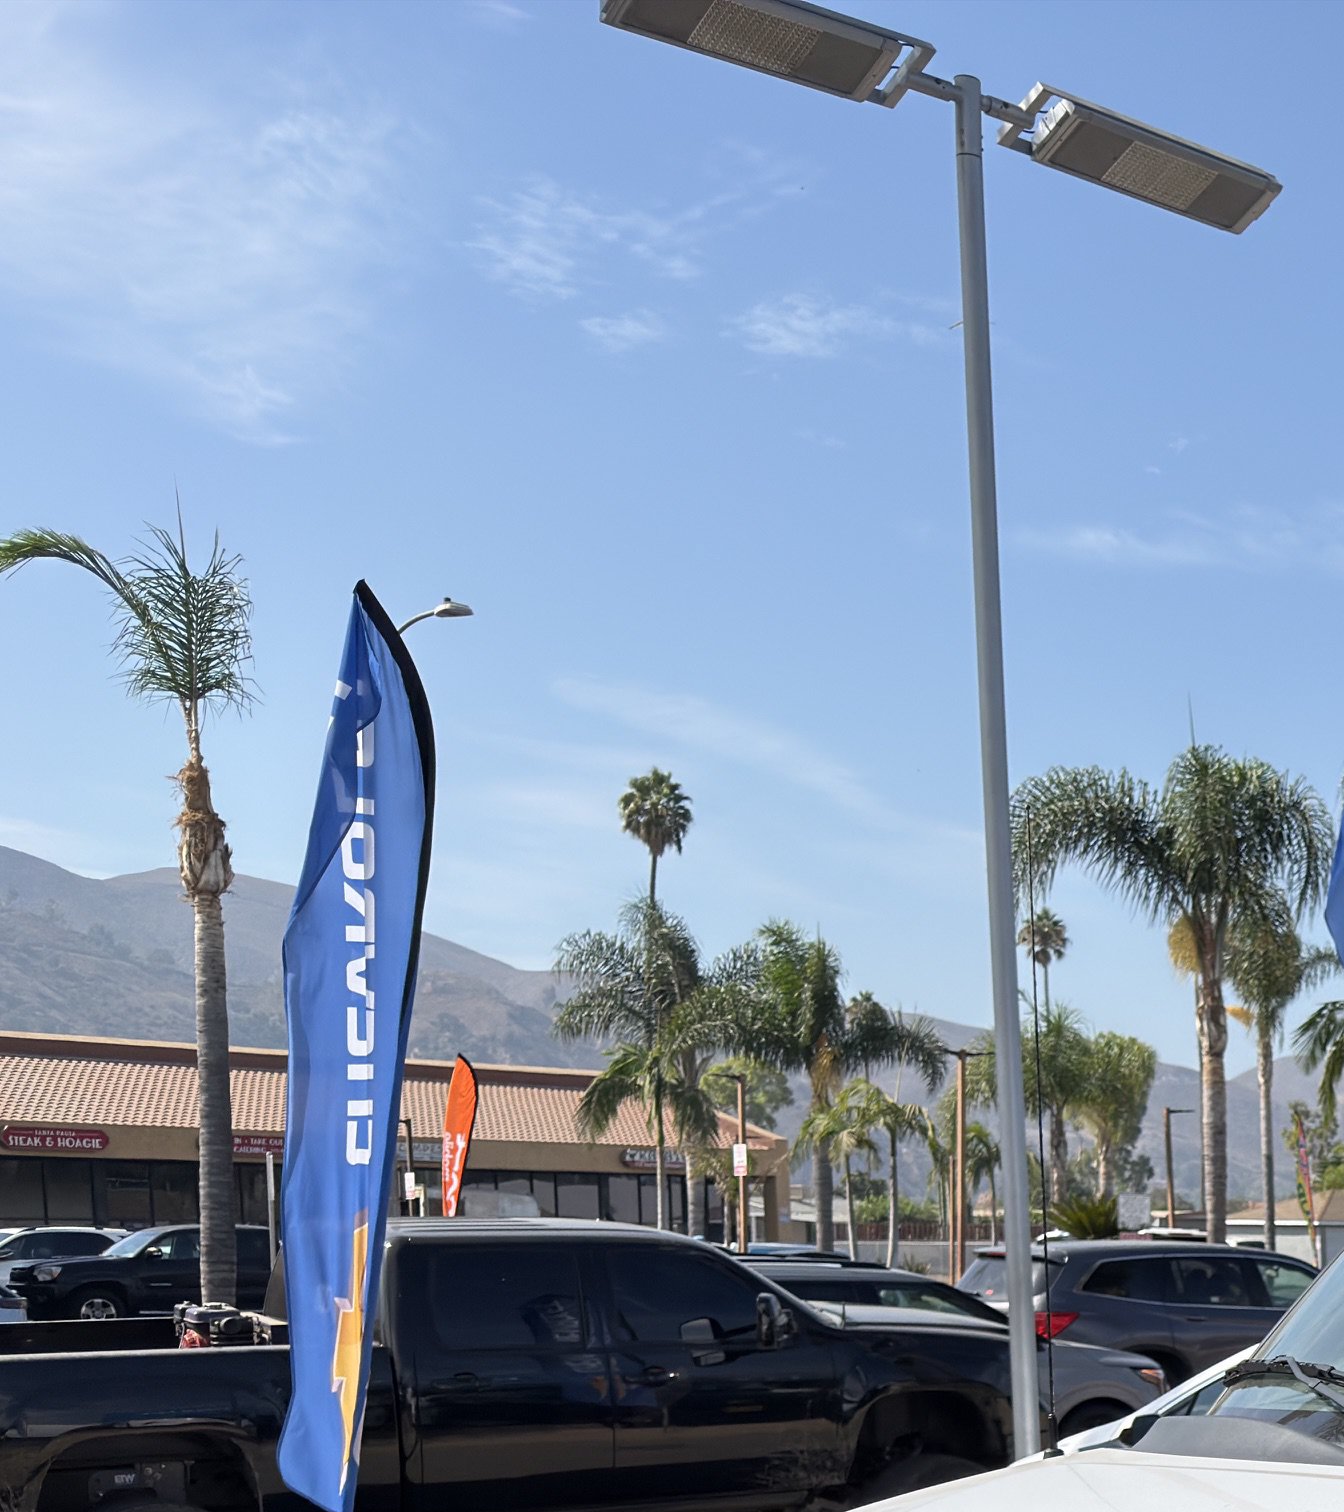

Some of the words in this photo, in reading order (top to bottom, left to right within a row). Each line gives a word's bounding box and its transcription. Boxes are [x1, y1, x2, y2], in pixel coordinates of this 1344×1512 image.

[8, 1135, 42, 1147] STEAK
[45, 1136, 54, 1147] &
[57, 1137, 103, 1149] HOAGIE
